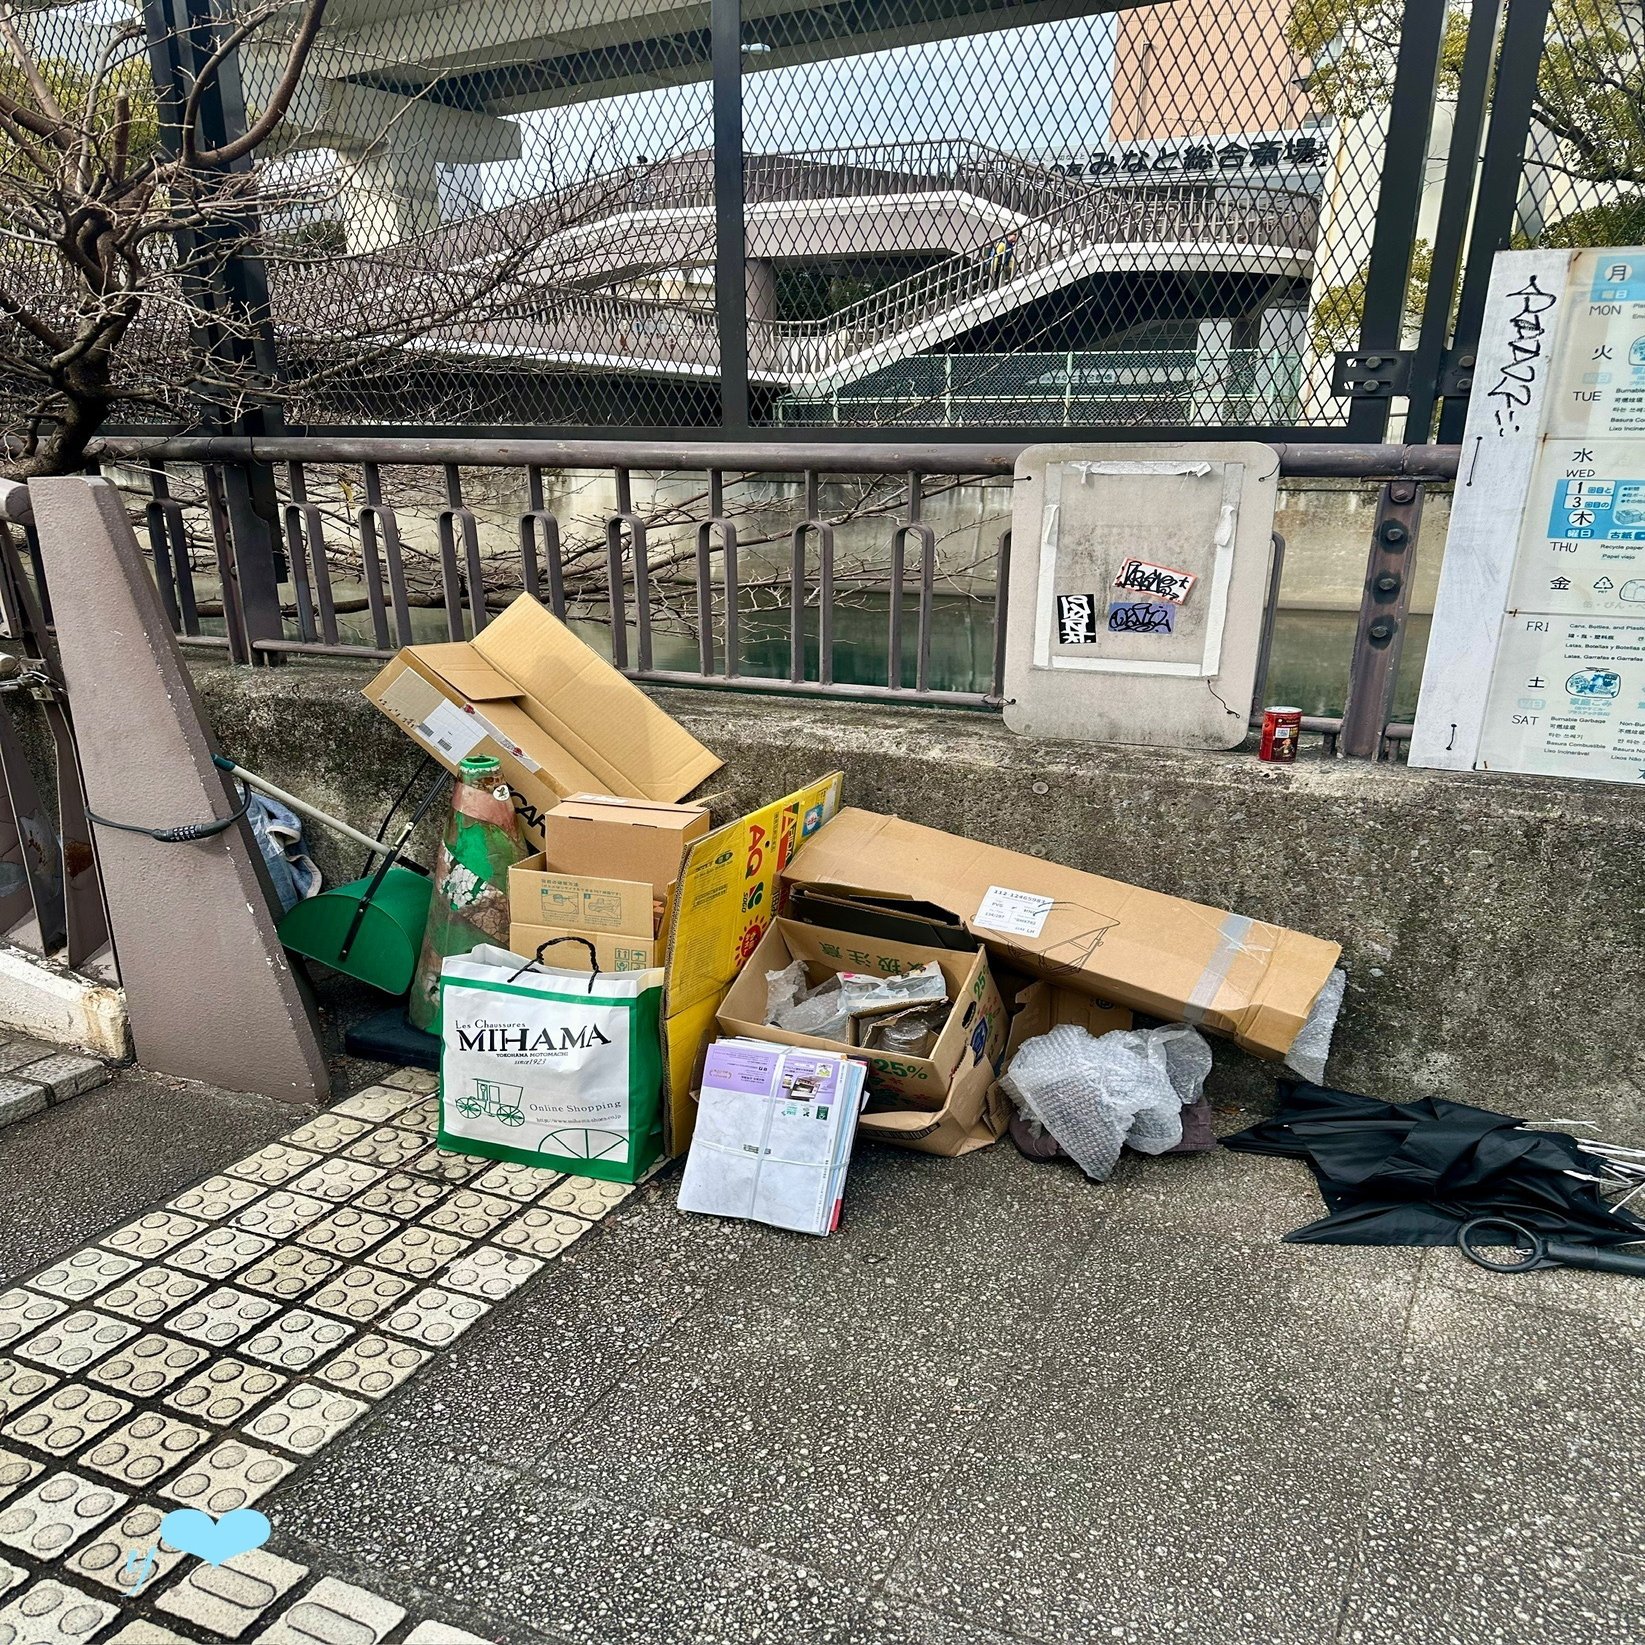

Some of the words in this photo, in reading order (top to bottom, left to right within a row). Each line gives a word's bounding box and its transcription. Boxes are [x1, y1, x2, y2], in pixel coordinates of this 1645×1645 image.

[1607, 264, 1627, 282] 月
[1589, 304, 1622, 316] MON
[1592, 344, 1613, 361] 火
[1573, 390, 1602, 402] TUE
[1571, 447, 1594, 463] 水
[1566, 468, 1596, 478] WED
[1571, 510, 1593, 526] 木
[1550, 541, 1578, 554] THU
[1549, 575, 1572, 591] 金
[1526, 620, 1550, 633] FRI
[1527, 676, 1545, 689] 土
[1511, 714, 1540, 726] SAT
[455, 1020, 472, 1030] Les
[474, 1019, 526, 1030] Chaussures
[456, 1023, 612, 1052] MIHAMA
[873, 1058, 928, 1080] 25%
[529, 1103, 564, 1113] Online
[566, 1100, 622, 1114] Shopping
